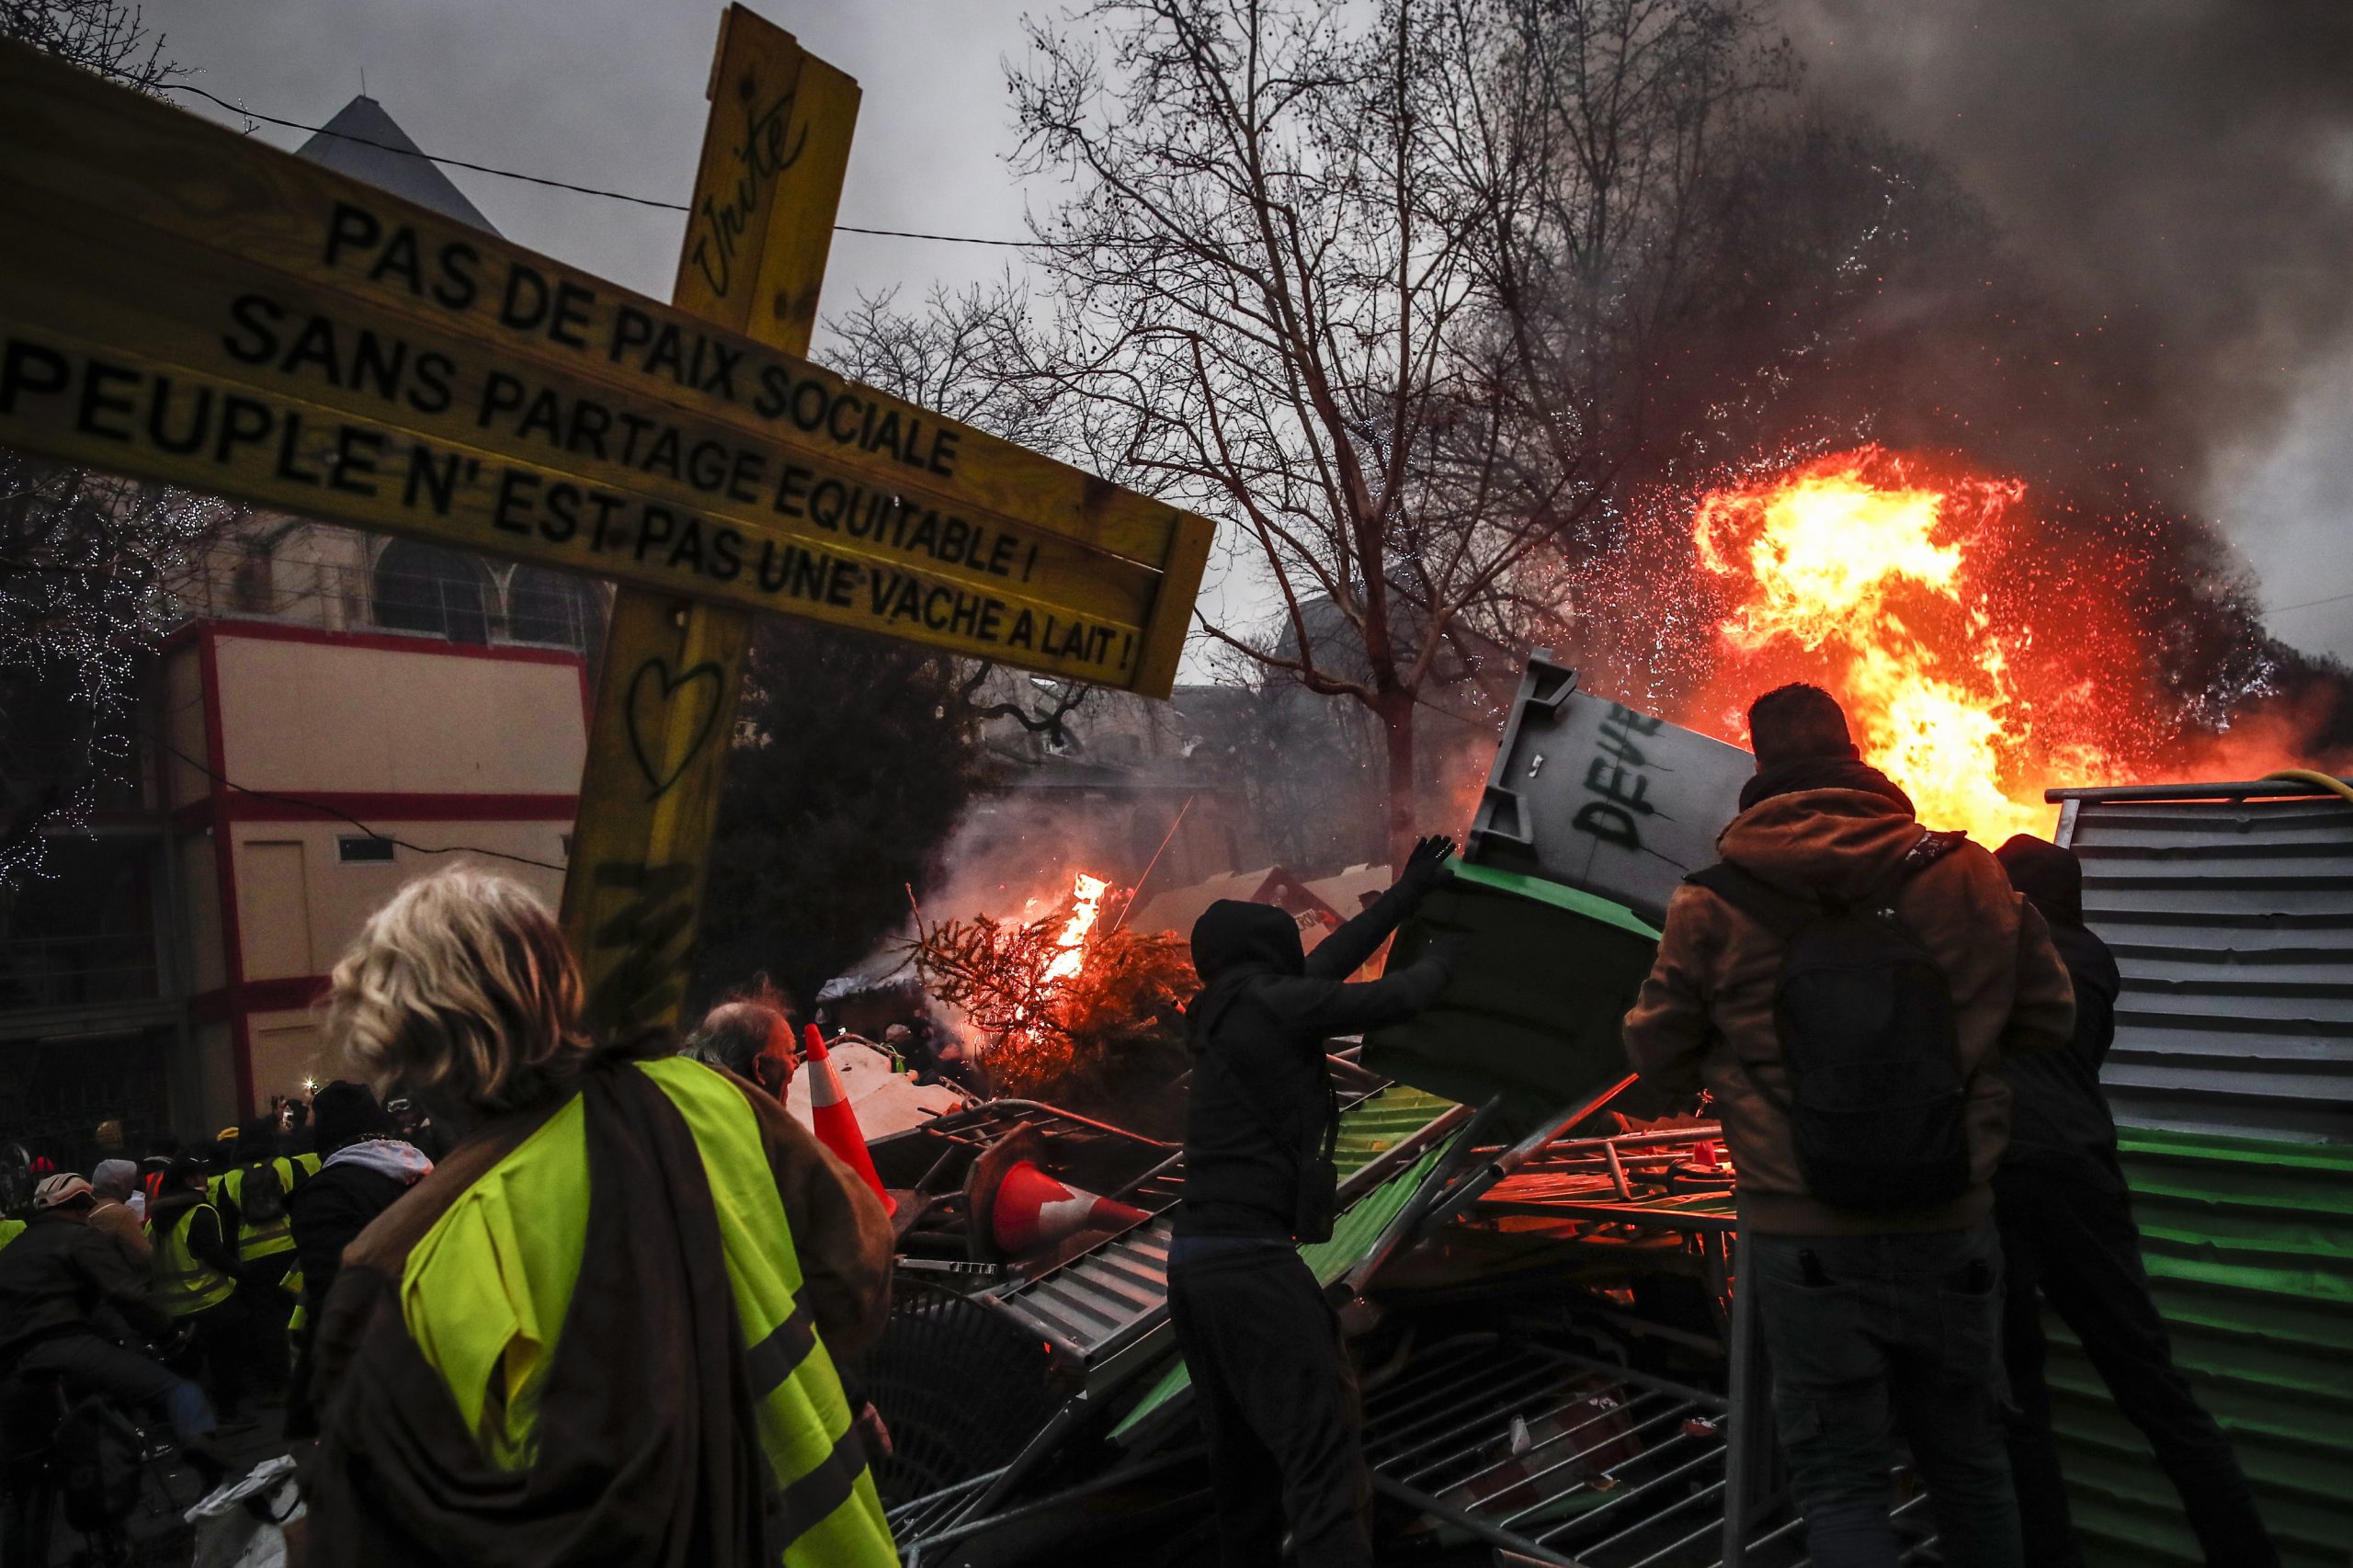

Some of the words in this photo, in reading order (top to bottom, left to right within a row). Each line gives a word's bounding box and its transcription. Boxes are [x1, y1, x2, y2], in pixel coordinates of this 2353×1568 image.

[222, 294, 455, 414] SANS
[477, 370, 766, 504] PARTAGE
[323, 201, 479, 311] PAS
[499, 262, 595, 351] DE
[609, 304, 746, 402] PAIX
[754, 364, 960, 478] SOCIALE
[0, 339, 387, 497] PEUPLE
[634, 508, 744, 580] PAS
[756, 539, 860, 607] UNE
[870, 568, 1005, 642] VACHE
[1007, 609, 1035, 650] A
